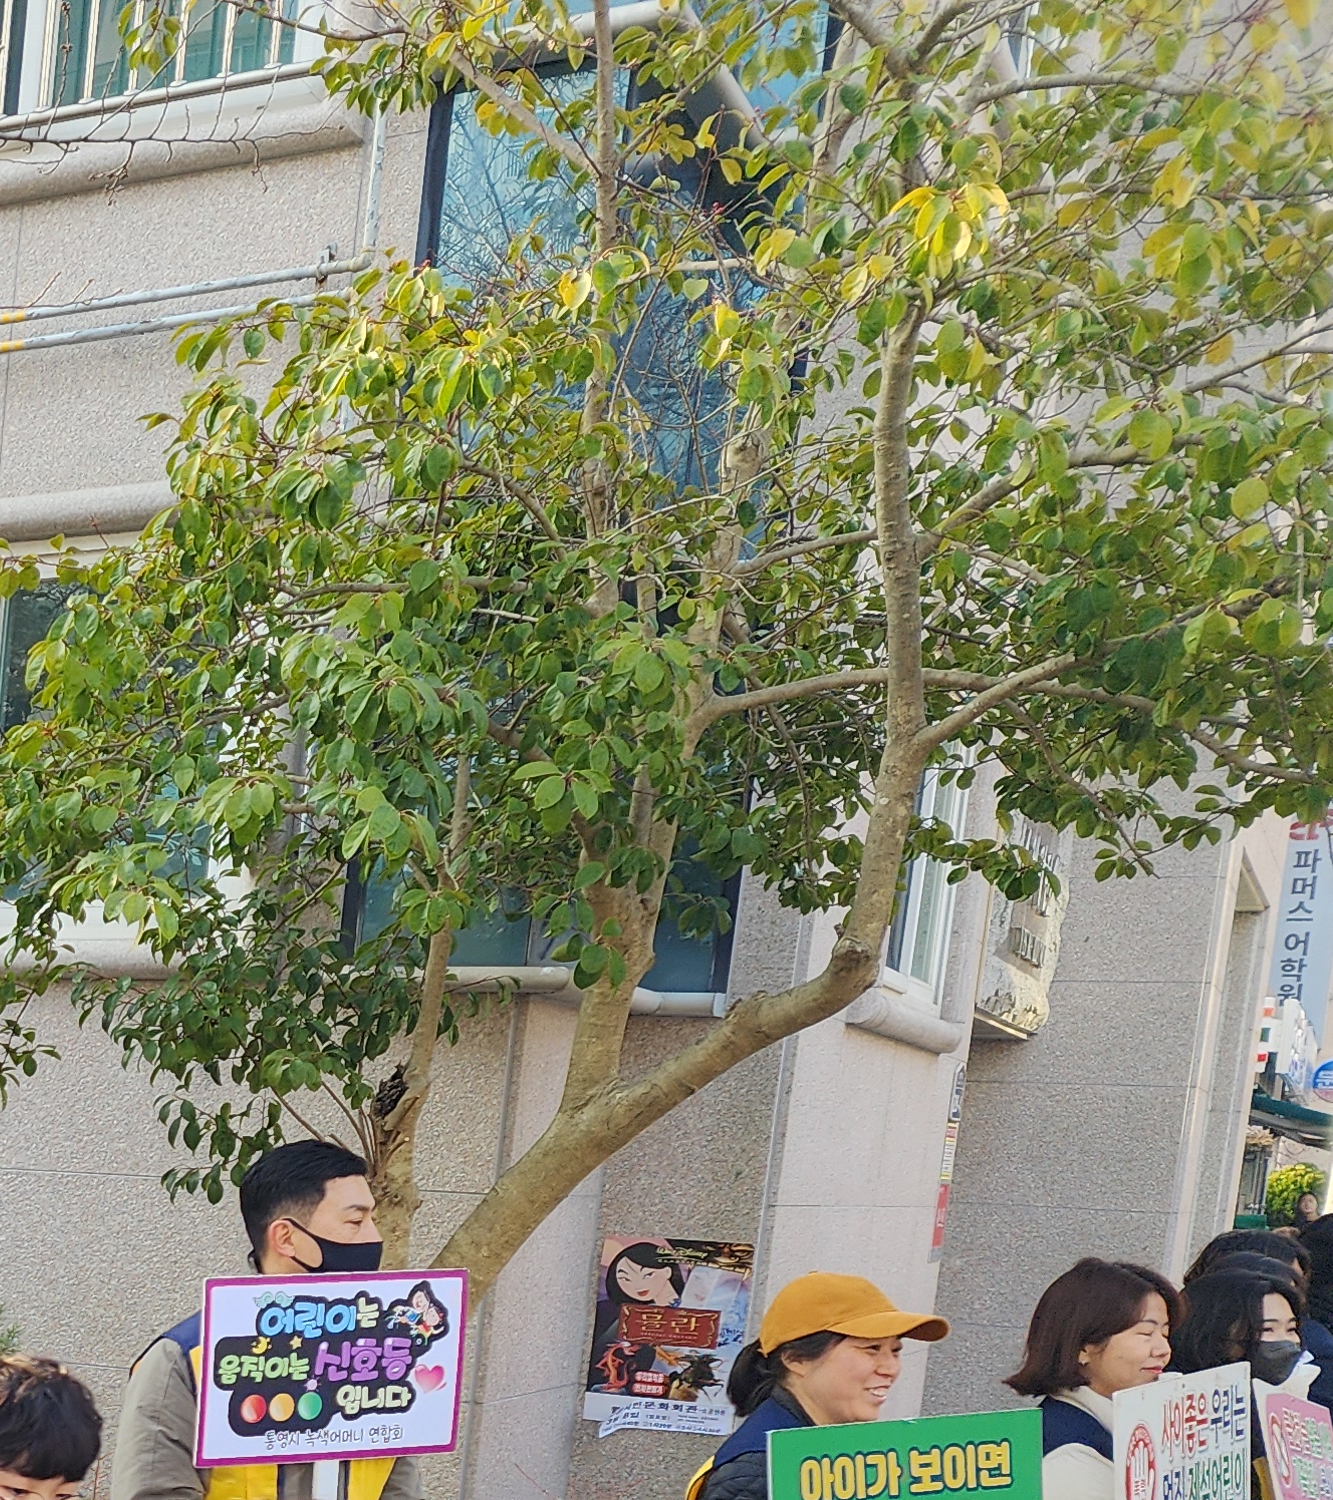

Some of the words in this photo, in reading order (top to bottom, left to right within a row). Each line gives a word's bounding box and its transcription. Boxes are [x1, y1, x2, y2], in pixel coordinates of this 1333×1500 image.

[1286, 848, 1322, 923] 파머스
[260, 1297, 380, 1339] 어린이는
[636, 1311, 701, 1336] 뮬란
[218, 1354, 311, 1383] 움직이는
[314, 1338, 413, 1381] 신호등
[336, 1384, 412, 1414] 입니다
[264, 1431, 300, 1451] 통영시
[305, 1430, 365, 1446] 녹색어머니
[369, 1425, 404, 1444] 연합회
[1161, 1391, 1209, 1462] 사이좋은
[1210, 1382, 1248, 1447] 우리는
[909, 1440, 1013, 1494] 보이면
